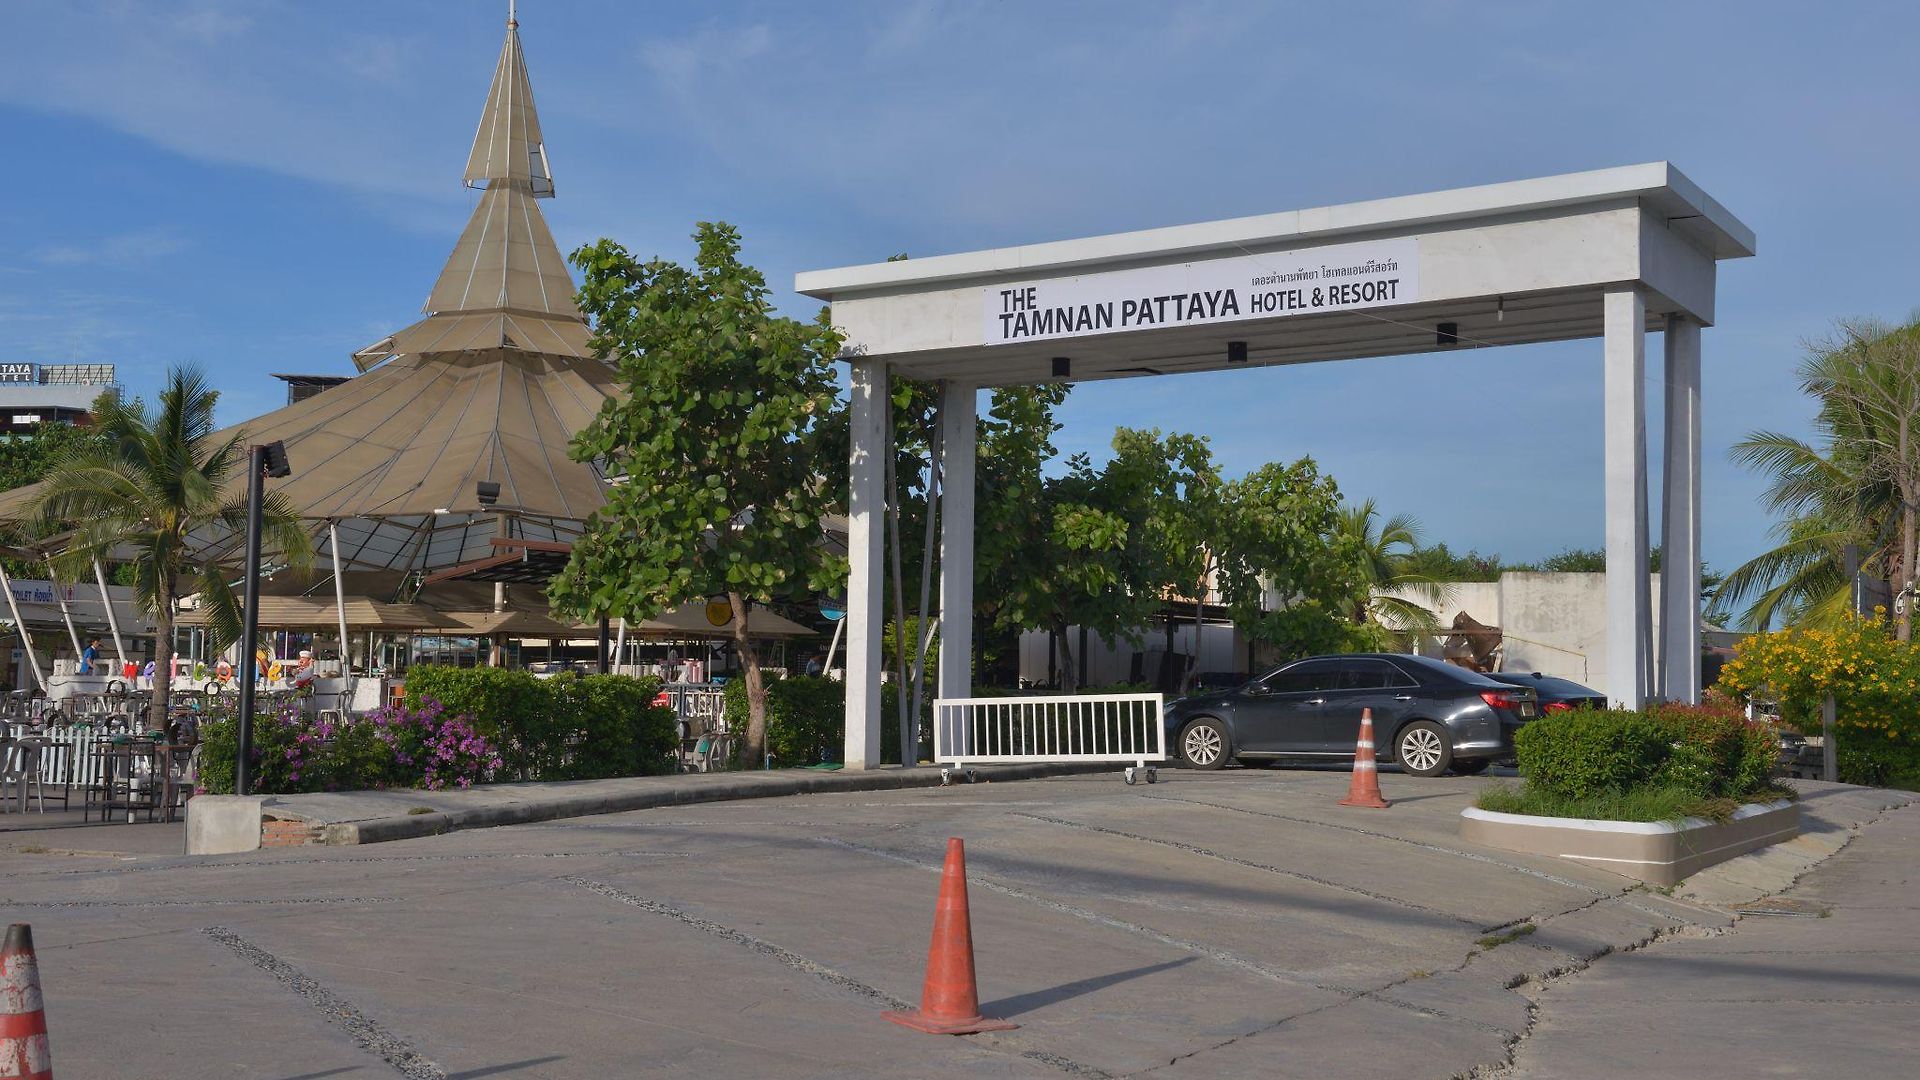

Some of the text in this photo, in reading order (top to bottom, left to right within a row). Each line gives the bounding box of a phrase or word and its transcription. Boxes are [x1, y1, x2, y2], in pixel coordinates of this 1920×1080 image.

[1000, 287, 1037, 313] THE
[1251, 278, 1399, 313] HOTEL & RESORT
[999, 288, 1240, 339] TAMNAN PATTAYA
